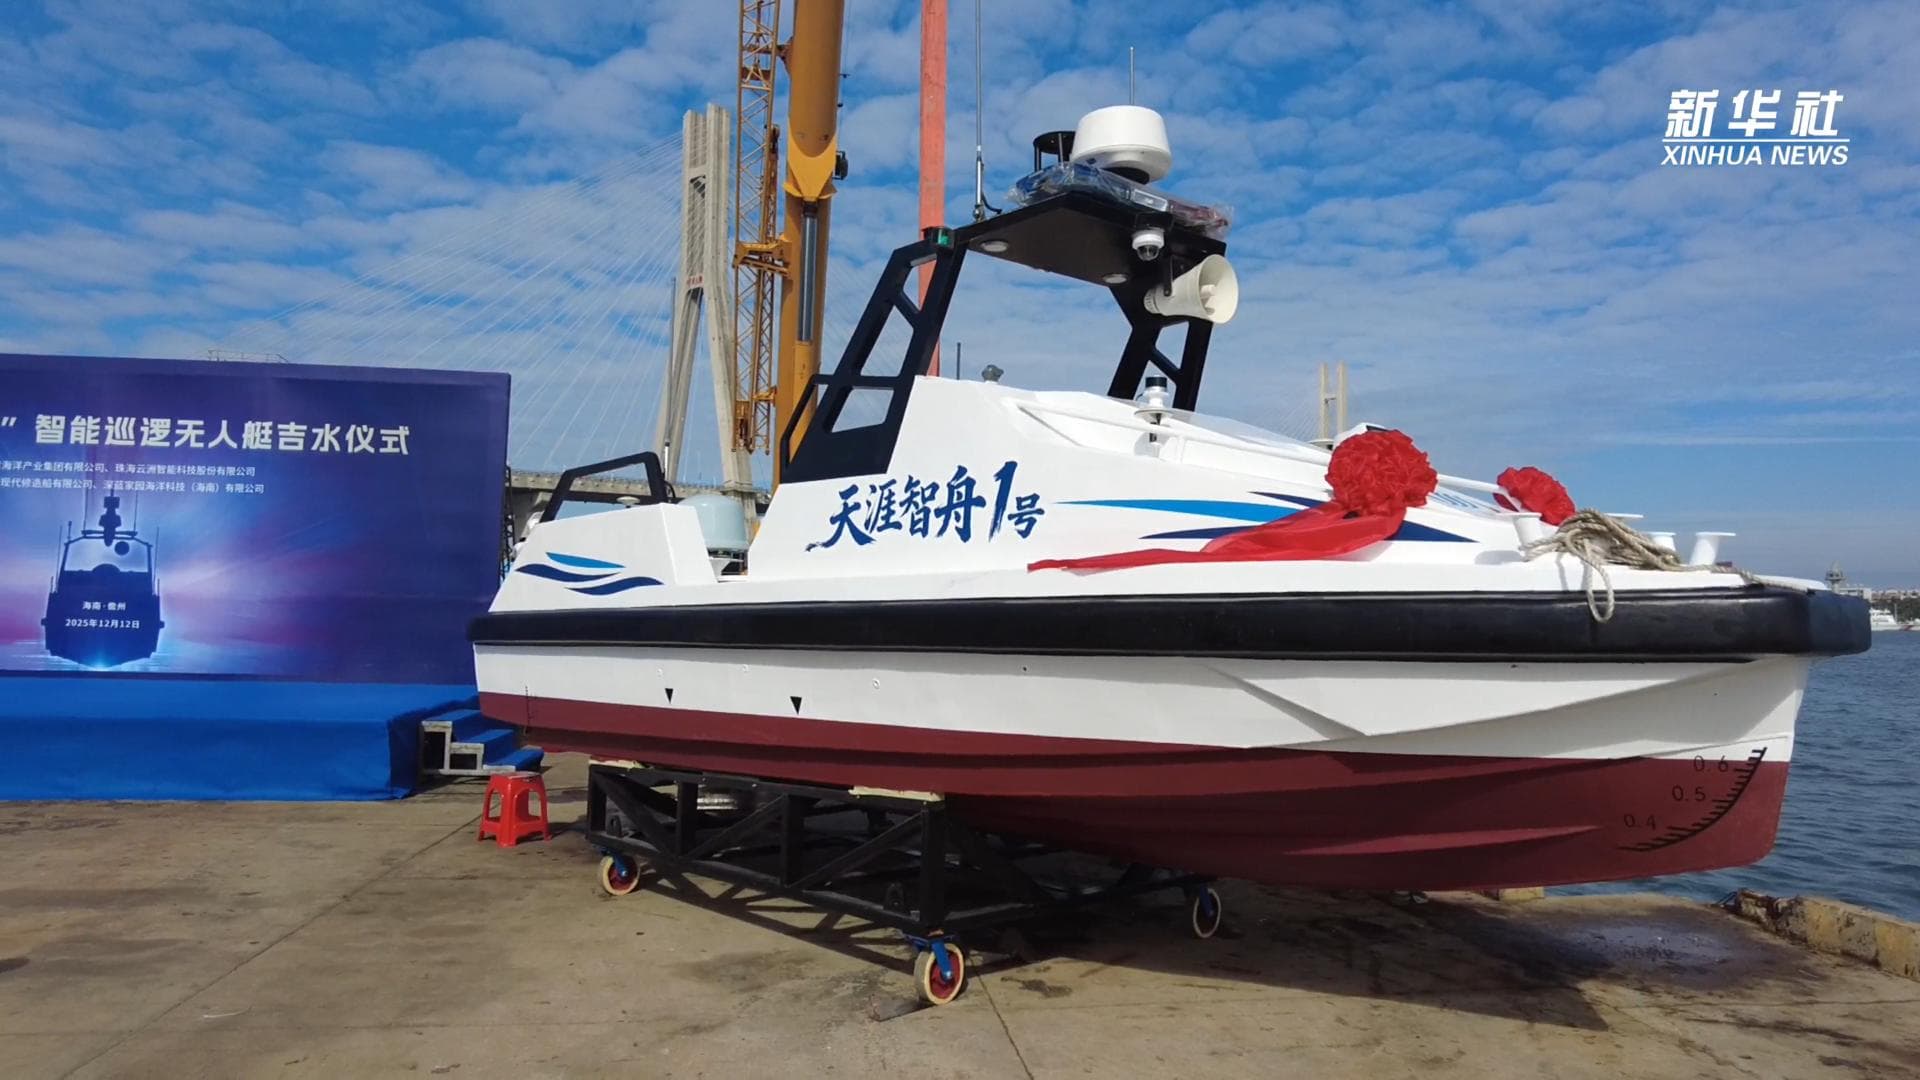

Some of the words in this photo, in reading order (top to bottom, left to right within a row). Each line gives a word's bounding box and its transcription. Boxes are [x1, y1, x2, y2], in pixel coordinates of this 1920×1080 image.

[805, 460, 1045, 552] 天涯智舟1号
[65, 618, 140, 629] 2025年12月12日
[1693, 755, 1729, 773] 0.6
[1671, 785, 1706, 802] 0.5
